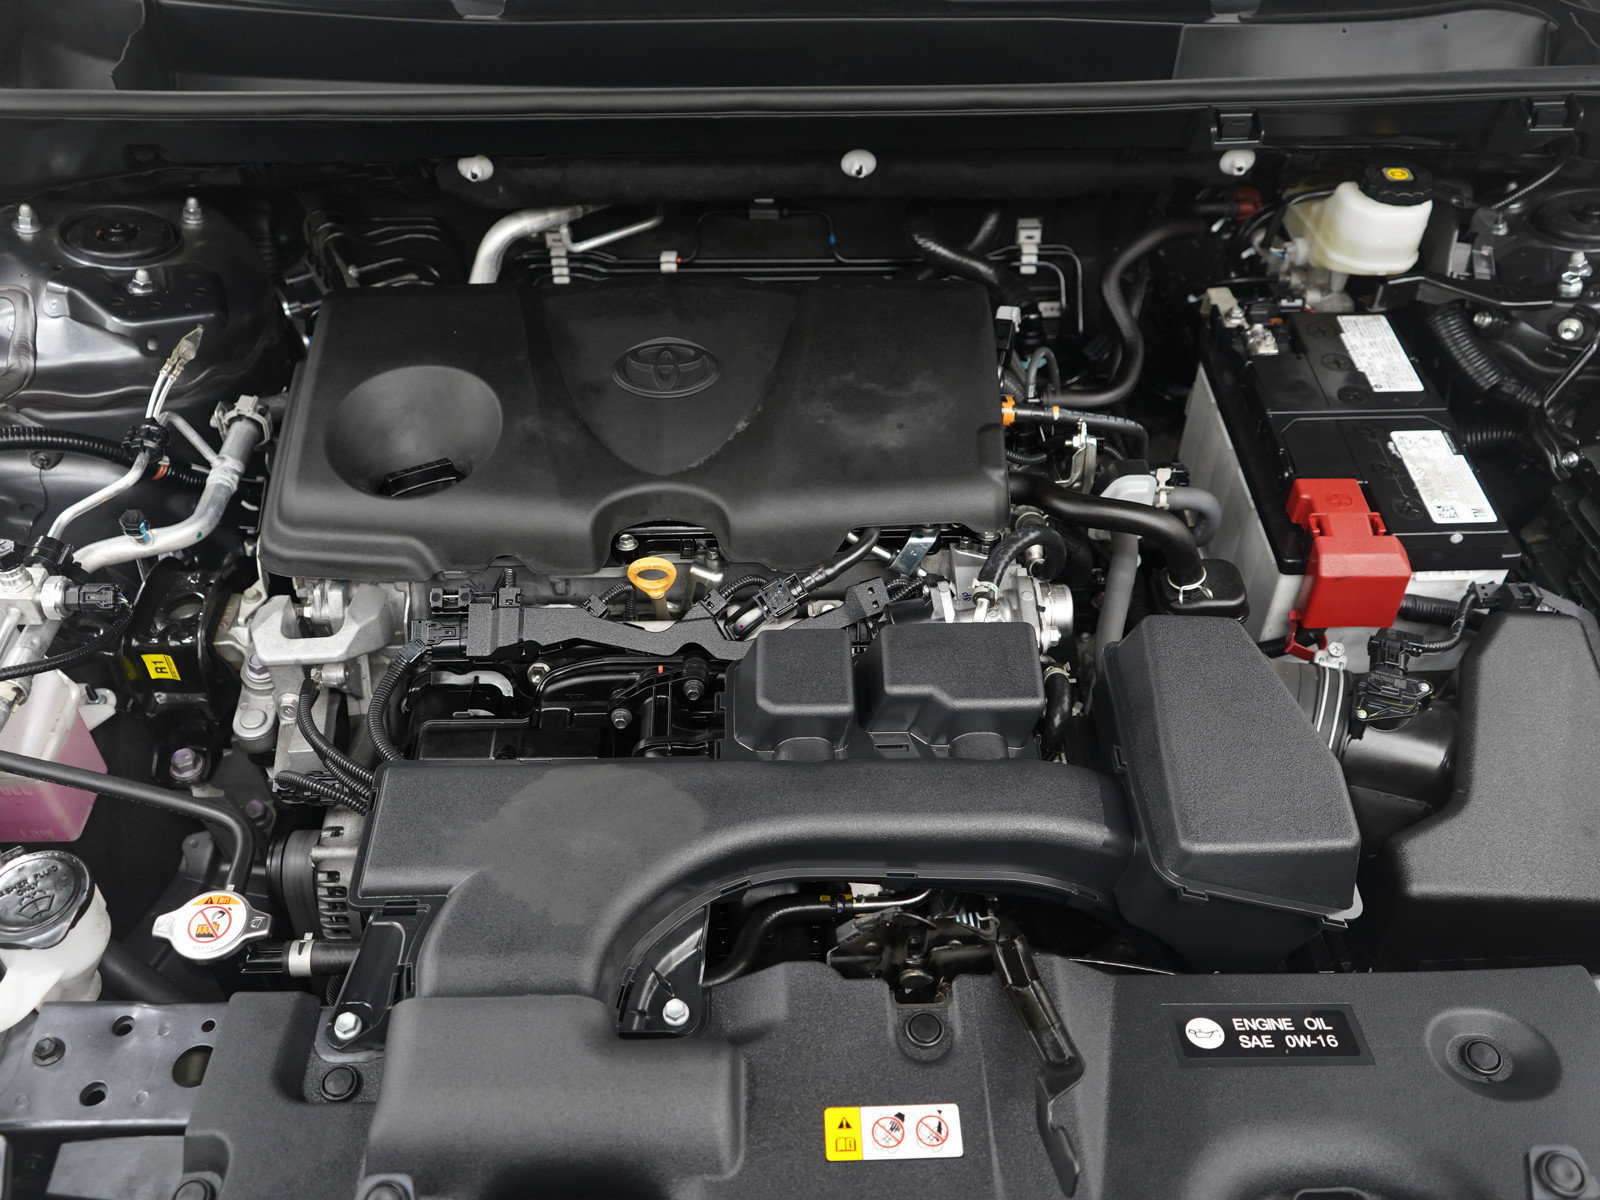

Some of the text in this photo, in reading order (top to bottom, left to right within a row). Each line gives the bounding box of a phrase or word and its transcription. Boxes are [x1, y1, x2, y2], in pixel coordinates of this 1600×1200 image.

[152, 661, 168, 673] R1
[33, 865, 59, 881] FLUID
[17, 880, 39, 896] ONLY
[1231, 1017, 1333, 1031] ENGINE OIL
[1238, 1034, 1339, 1049] SAE 0W-16
